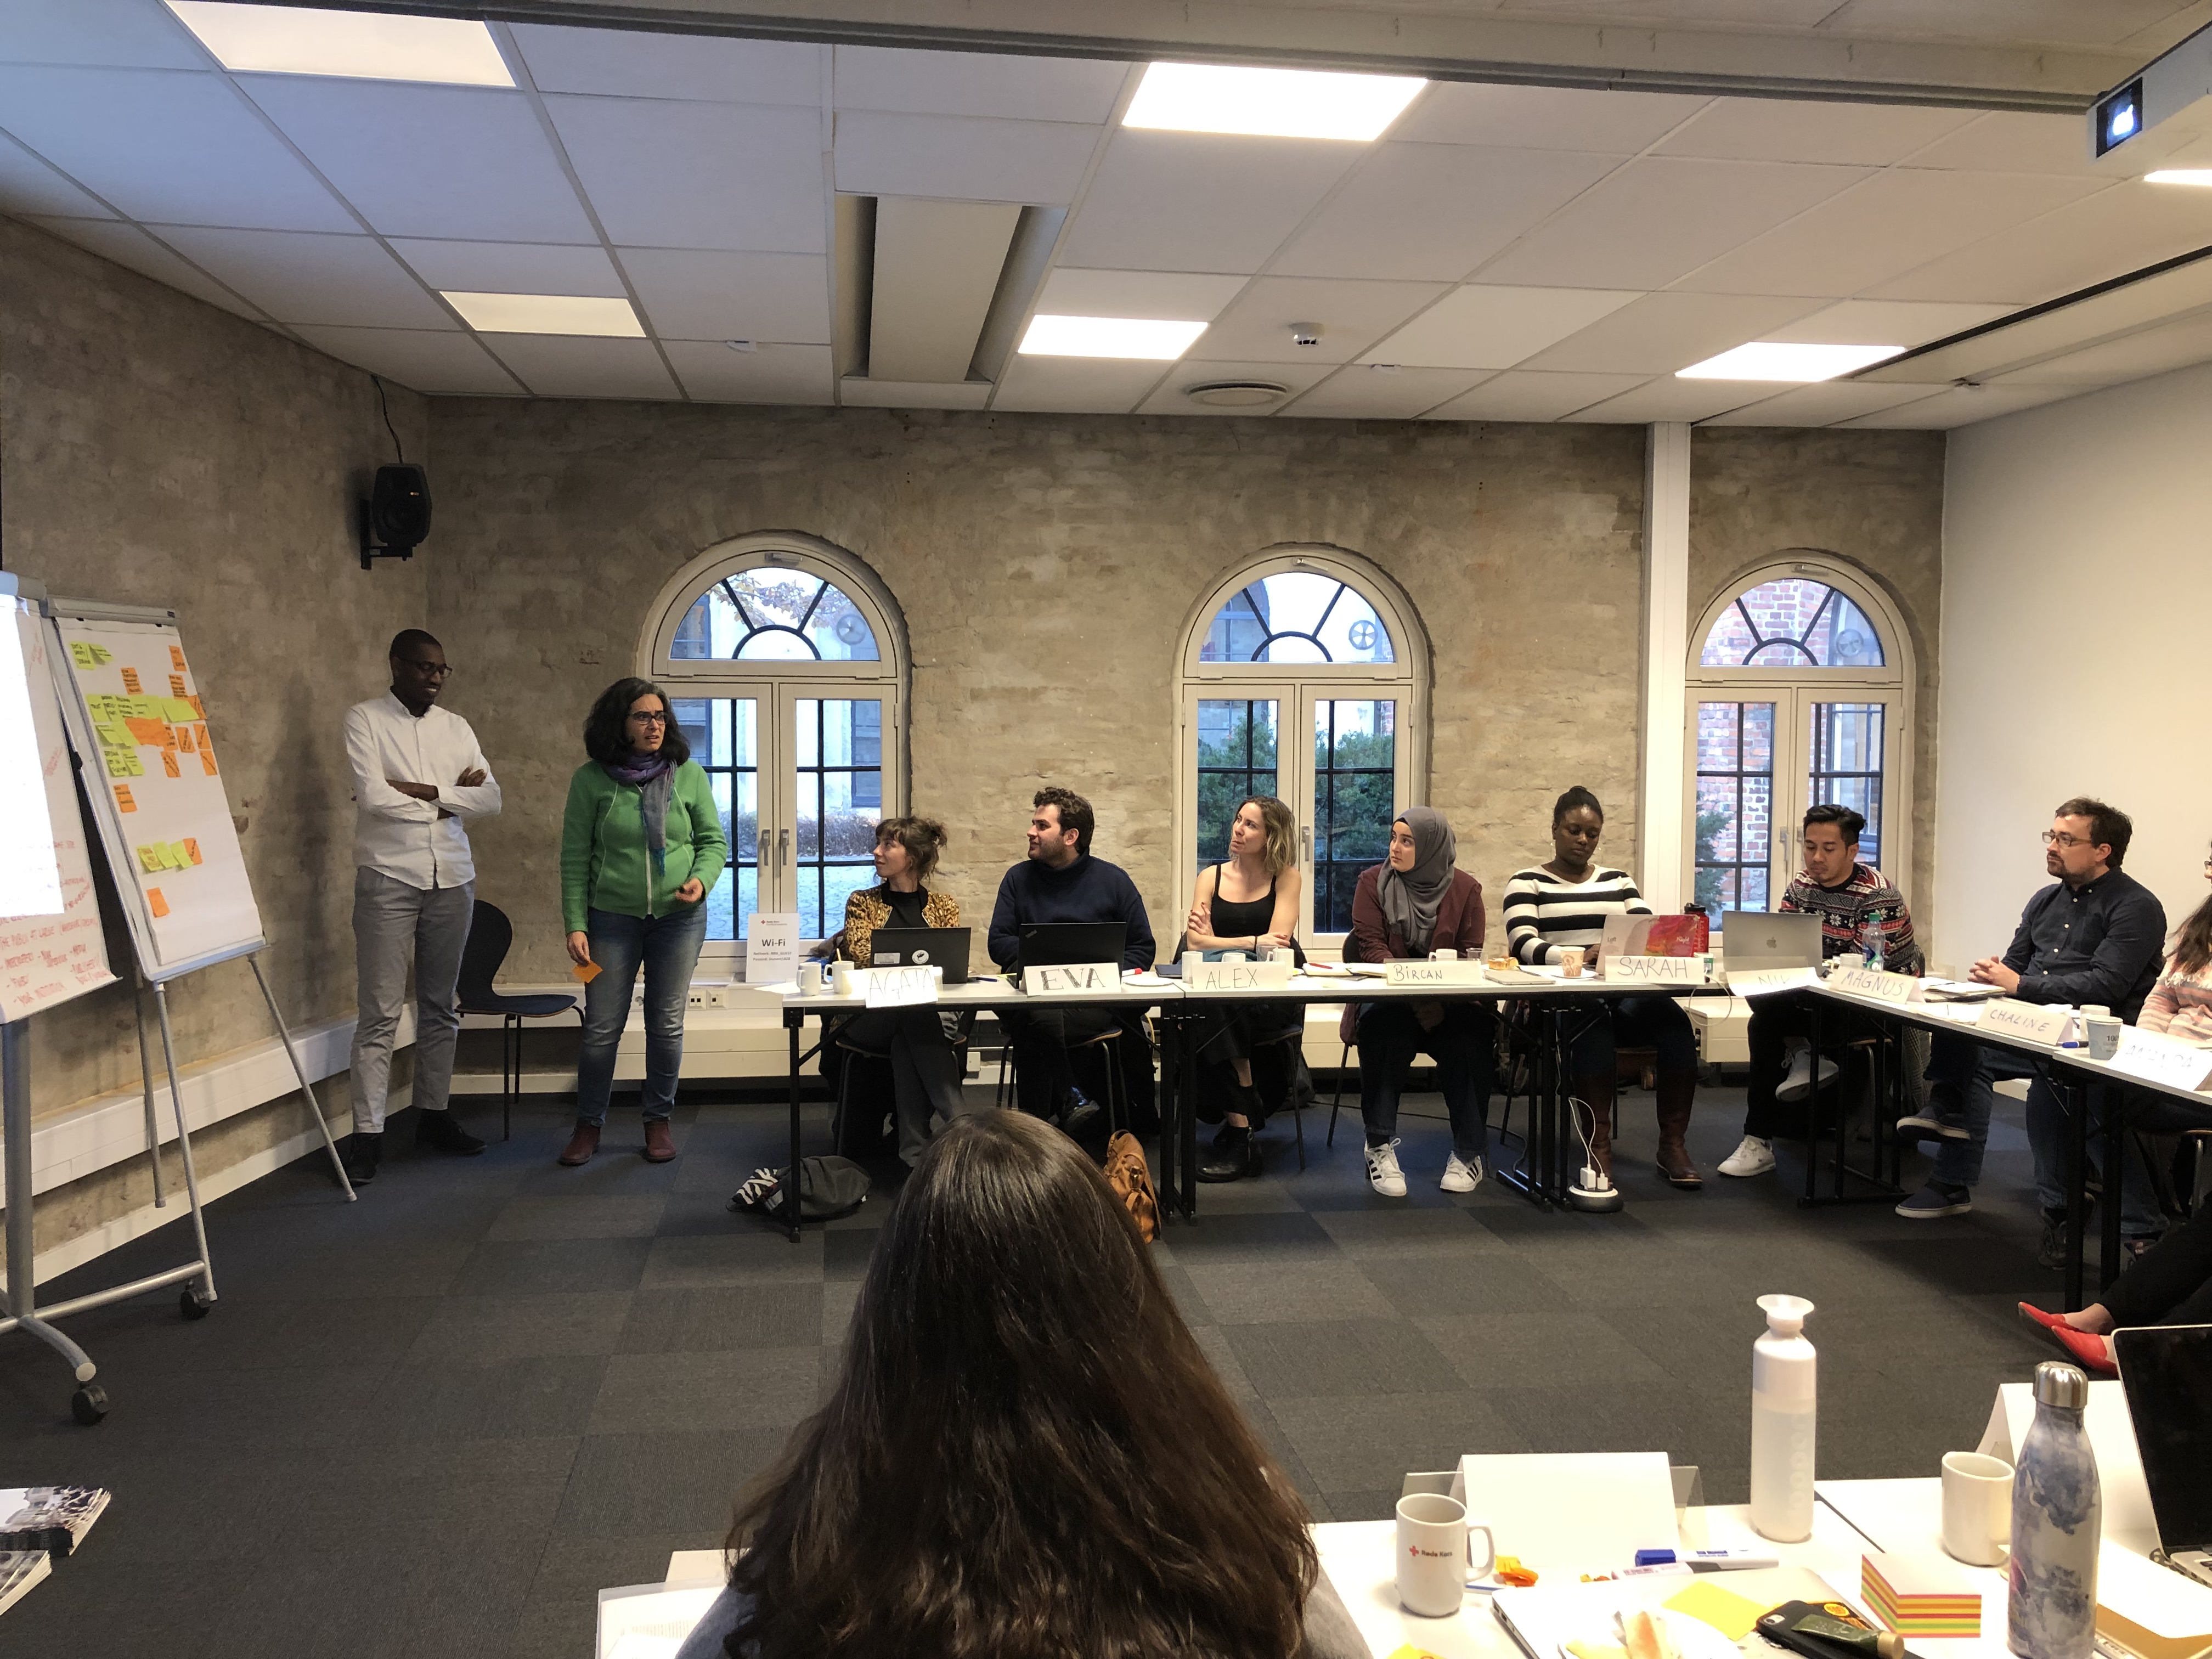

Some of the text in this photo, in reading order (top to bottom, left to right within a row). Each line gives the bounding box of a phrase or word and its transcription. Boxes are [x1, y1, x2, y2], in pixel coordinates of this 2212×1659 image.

[1206, 968, 1258, 990] ALEX
[1617, 956, 1688, 979] SARAH
[870, 968, 934, 1003] AGATA
[1040, 968, 1106, 991] EVA
[1841, 970, 1904, 996] MAGNUS
[1990, 1009, 2051, 1032] CHALINE
